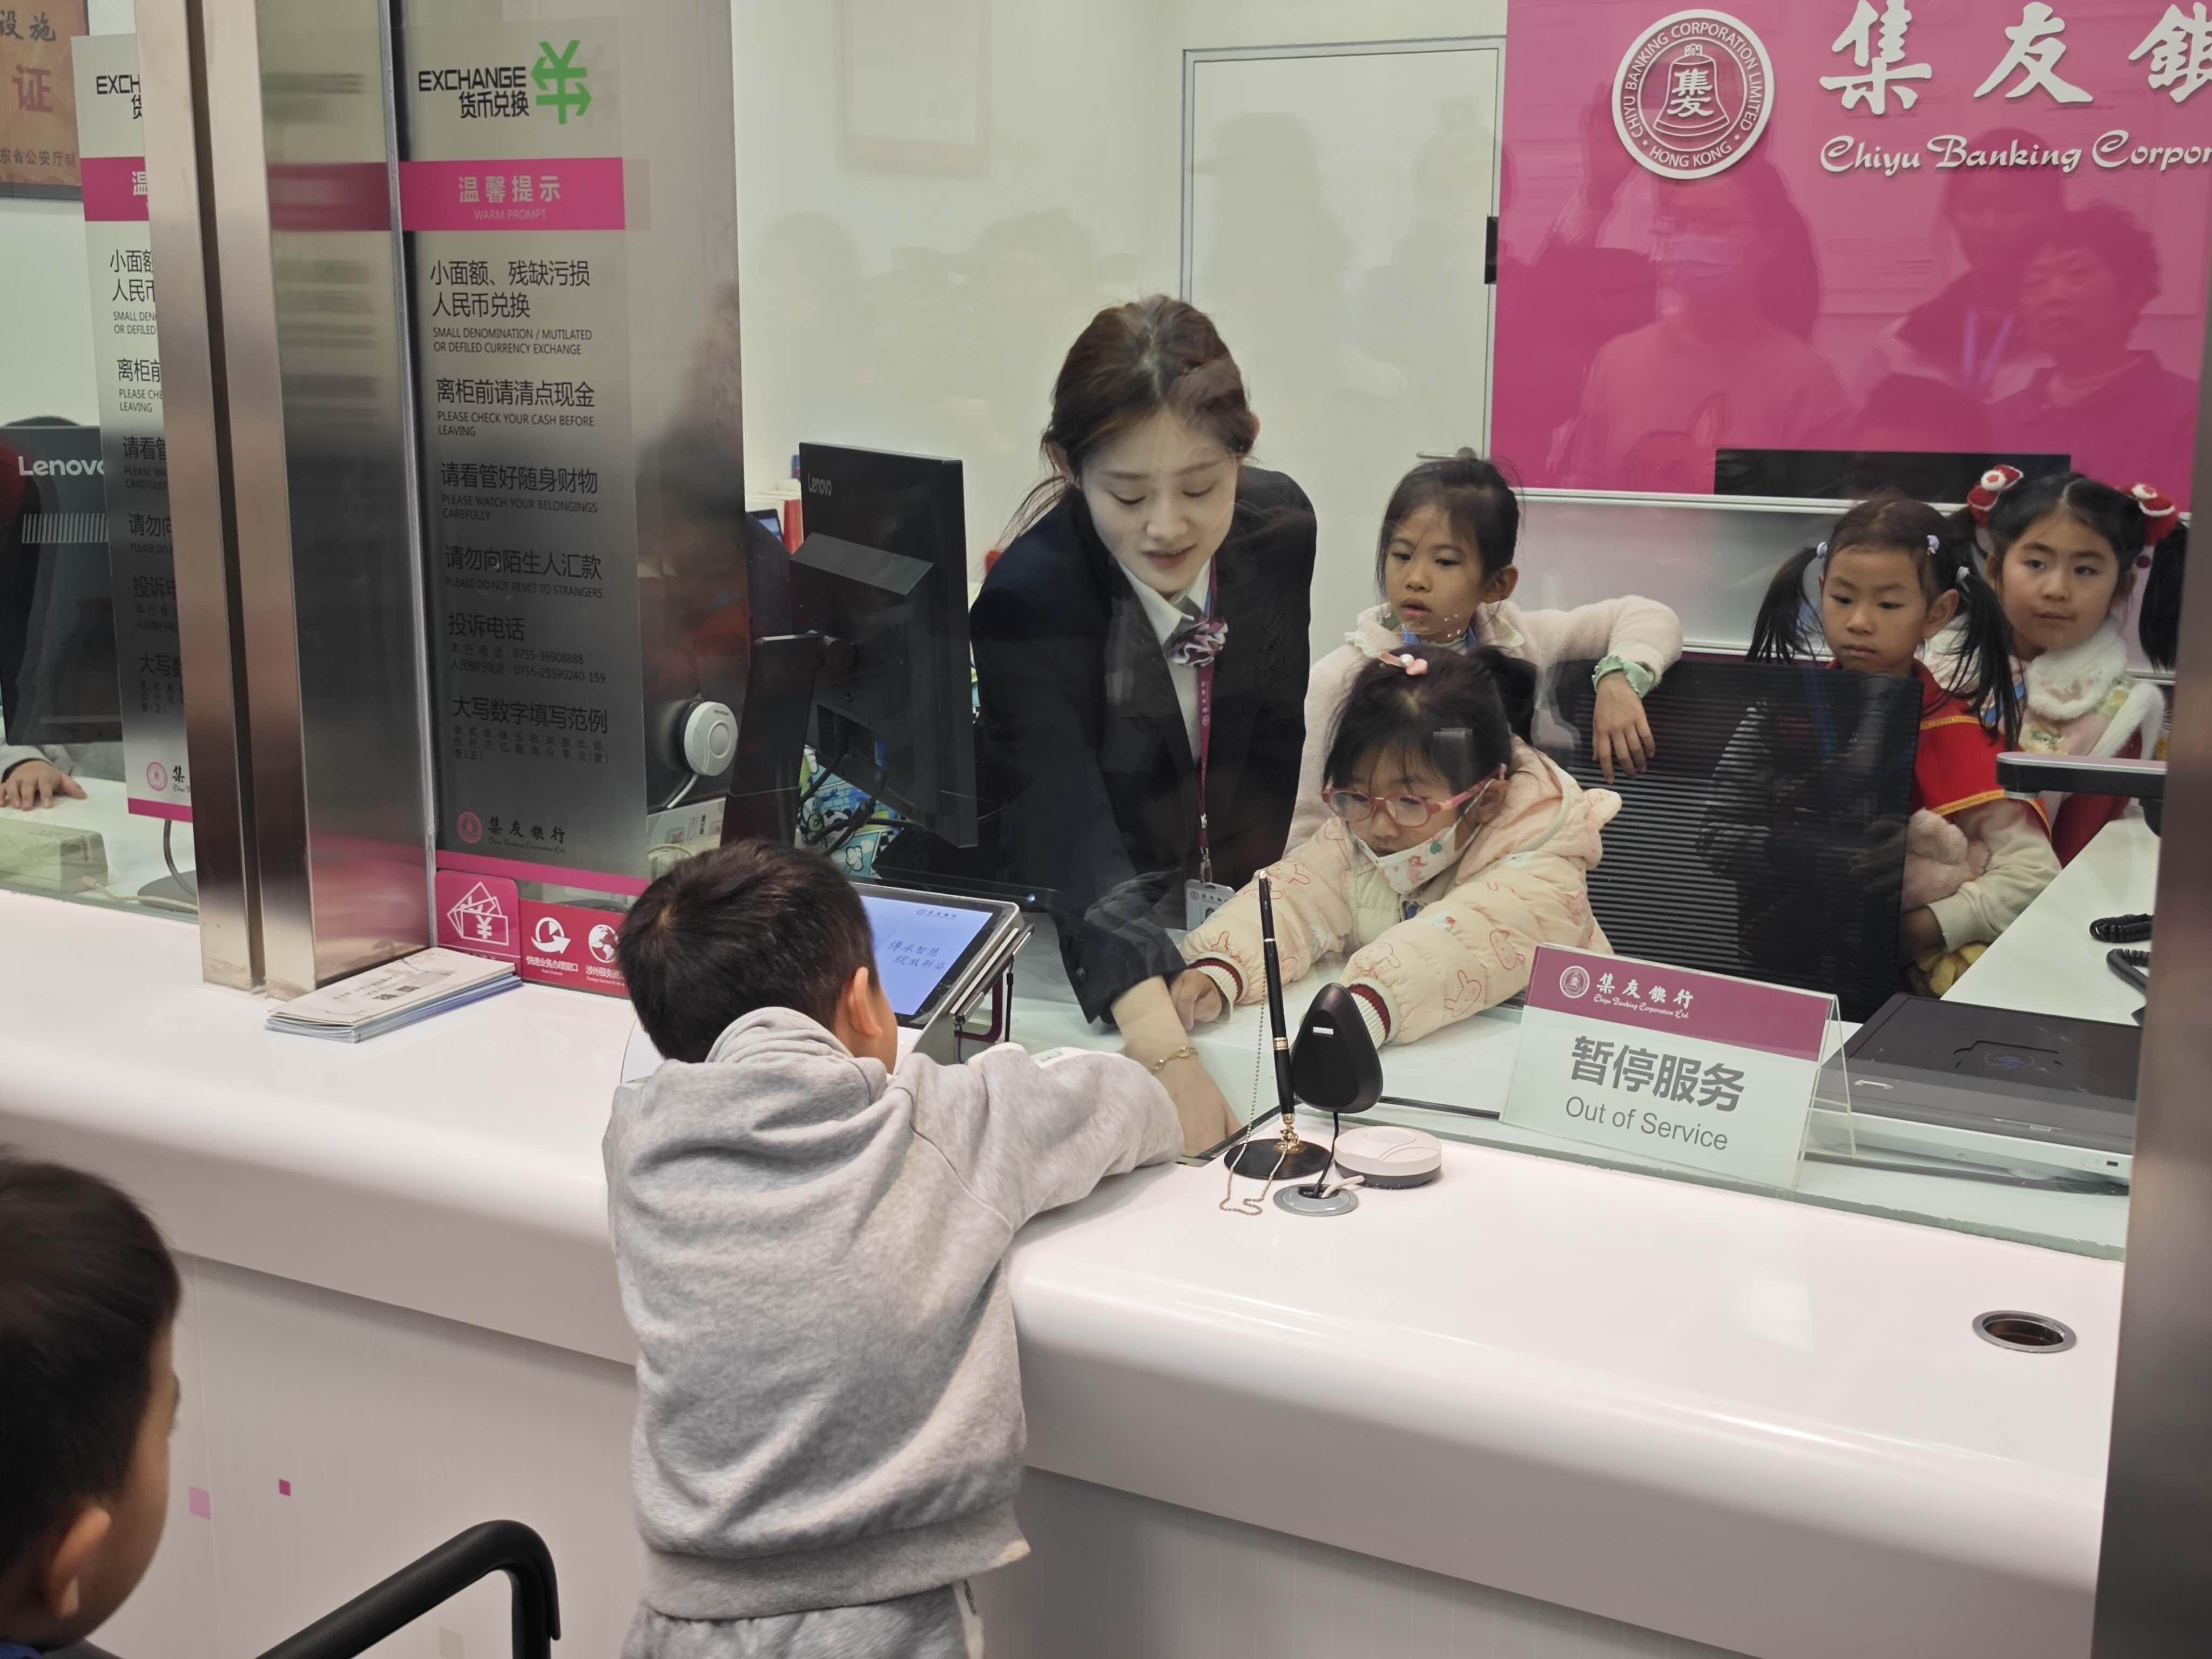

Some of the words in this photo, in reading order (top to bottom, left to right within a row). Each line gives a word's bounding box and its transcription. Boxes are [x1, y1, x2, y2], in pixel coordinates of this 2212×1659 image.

[1671, 22, 1758, 70] CORPORATION
[1626, 33, 1669, 90] BANKING
[12, 64, 53, 112] 证
[418, 66, 527, 91] EXCHANGE
[459, 91, 530, 119] 货币兑换
[1667, 68, 1714, 117] 集友
[1740, 72, 1762, 131] LIMITED
[1623, 96, 1643, 138] CHIYU
[1649, 145, 1690, 167] HONG
[1693, 141, 1732, 166] KONG
[1819, 134, 1920, 177] Chiyu
[1927, 134, 2082, 173] Banking
[458, 176, 561, 204] 温馨提示
[474, 209, 504, 220] WARM
[507, 209, 548, 220] PROMPT
[430, 260, 590, 286] 小面额、残缺污损
[113, 311, 137, 322] SMALL
[139, 312, 157, 322] DEN
[433, 292, 530, 318] 人民币兑换
[114, 325, 125, 334] OR
[127, 325, 156, 335] DEFILED
[433, 327, 461, 338] SMALL
[463, 328, 533, 339] DENOMINATION
[542, 329, 592, 340] MUTILATED
[434, 342, 447, 352] OR
[449, 342, 482, 353] DEFILED
[484, 343, 531, 354] CURRENCY
[534, 343, 582, 355] EXCHANGE
[119, 389, 146, 399] PLEASE
[436, 378, 595, 407] 离柜前请清点现金
[120, 402, 152, 413] LEAVING
[437, 411, 469, 422] PLEASE
[471, 412, 502, 423] CHECK
[503, 413, 529, 424] YOUR
[531, 415, 556, 426] CASH
[559, 415, 594, 427] BEFORE
[439, 426, 476, 436] LEAVING
[441, 462, 598, 494] 请看管好随身财物
[442, 494, 476, 506] PLEASE
[476, 496, 508, 508] WATCH
[510, 498, 535, 509] YOUR
[537, 500, 598, 513] BELONGINGS
[442, 508, 490, 521] CAREFULLY
[445, 545, 602, 580] 请勿向陌生人汇款
[446, 576, 474, 588] PLEASE
[476, 578, 490, 590] DO
[492, 579, 509, 592] NOT
[539, 584, 551, 595] TO
[554, 585, 603, 598] STRANGERS
[449, 611, 525, 642] 投诉电话
[453, 694, 608, 734] 大写数字填写范例
[1596, 973, 1694, 1009] 集友銀行
[1594, 994, 1611, 1004] Chiyu
[1612, 997, 1638, 1010] Banking
[1639, 1002, 1674, 1016] Corporation
[1571, 1035, 1745, 1112] 暂停服务
[1566, 1096, 1605, 1125] Out
[1612, 1109, 1636, 1130] of
[1641, 1112, 1728, 1151] Service
